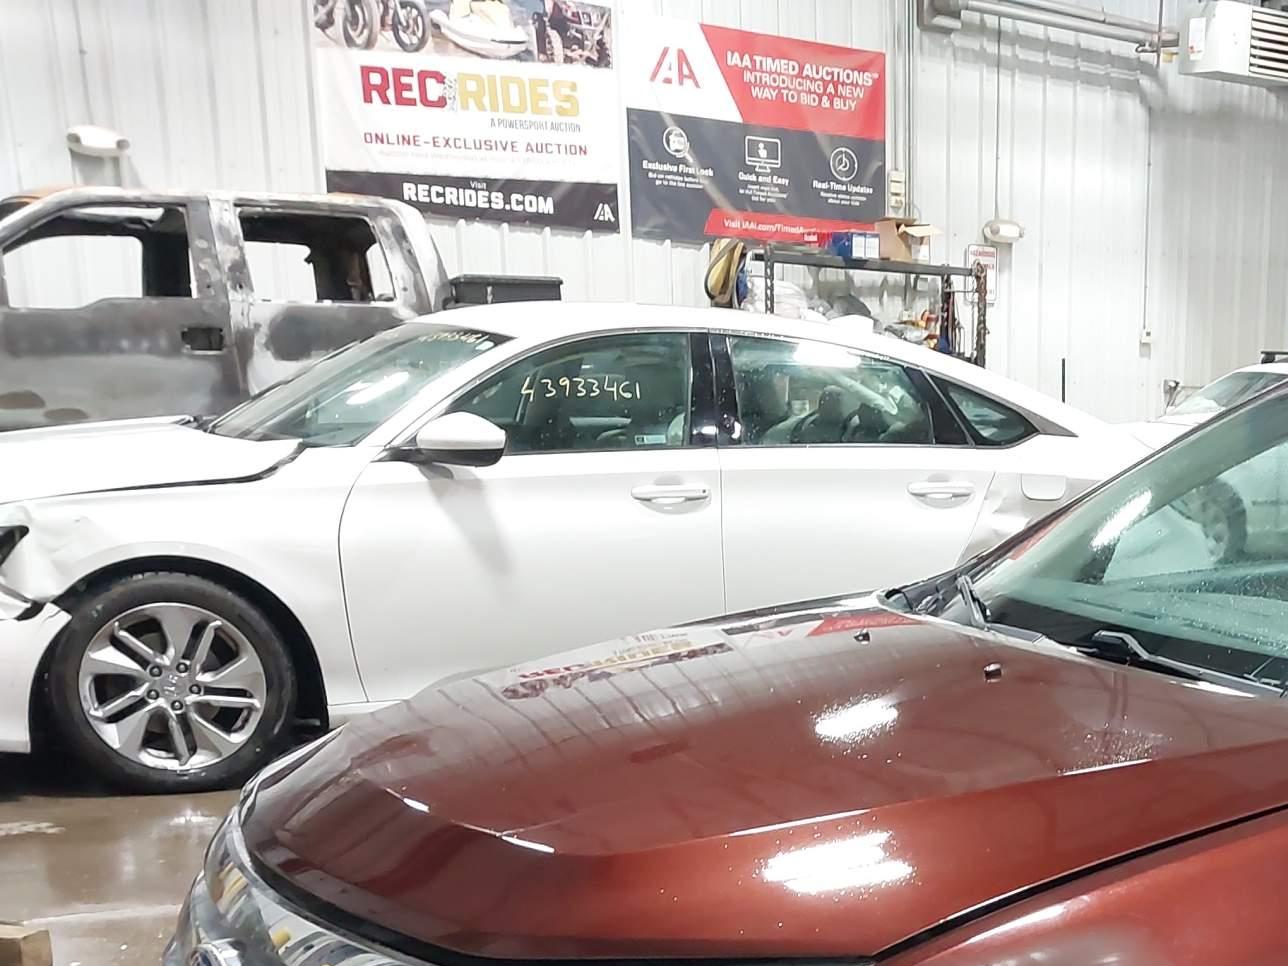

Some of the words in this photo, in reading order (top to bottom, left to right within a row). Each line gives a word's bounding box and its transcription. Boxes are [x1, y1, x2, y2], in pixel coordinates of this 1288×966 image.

[726, 50, 752, 68] IAA
[753, 55, 799, 75] TIMED
[743, 70, 823, 94] INTRODUCING
[826, 83, 835, 95] A
[838, 84, 865, 99] NEW
[751, 85, 778, 100] WAY
[781, 89, 797, 103] TO
[800, 92, 818, 107] BID
[821, 95, 830, 108] &
[833, 97, 857, 111] BUY
[490, 118, 496, 128] A
[550, 121, 581, 133] AUCTION
[364, 132, 519, 153] ONLINE-EXCLUSIVE
[526, 141, 587, 156] AUCTION
[642, 160, 678, 172] Exclusive
[679, 164, 695, 174] First
[470, 180, 487, 190] Visit
[738, 171, 757, 181] Quick
[758, 175, 772, 183] and
[772, 176, 789, 186] Easy
[812, 180, 847, 191] Real-Time
[847, 184, 873, 194] Updates
[402, 182, 554, 214] RECRIDES.COM
[723, 218, 740, 228] Visit
[521, 375, 641, 402] 43933461
